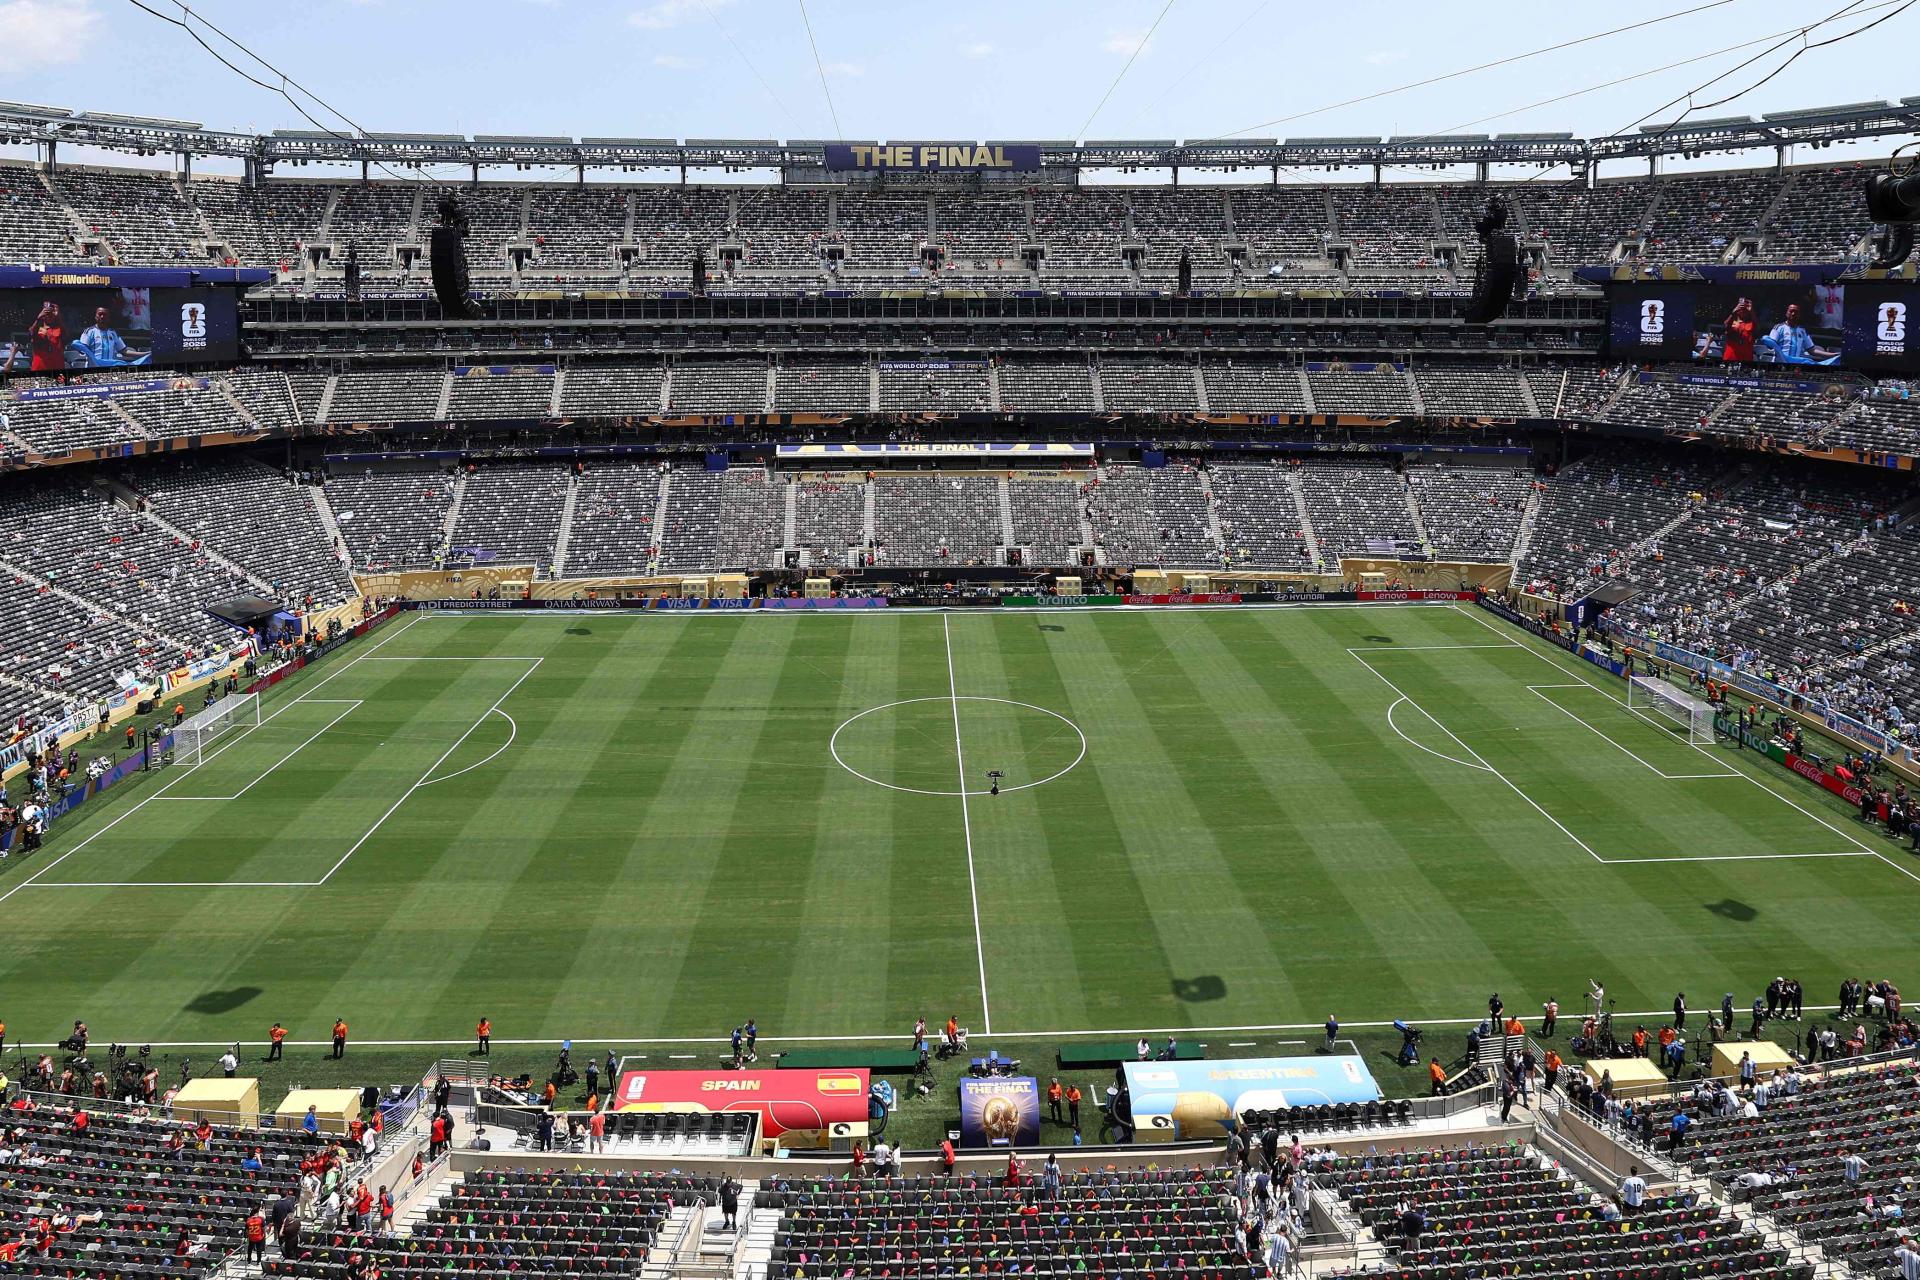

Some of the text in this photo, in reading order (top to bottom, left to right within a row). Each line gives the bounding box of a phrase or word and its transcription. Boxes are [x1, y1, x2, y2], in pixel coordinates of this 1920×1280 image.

[850, 146, 1012, 166] THE FINAL
[1736, 270, 1800, 280] #FIFAWorldCup
[41, 274, 111, 286] #FIFAWorldCup
[704, 416, 734, 425] THE
[1248, 415, 1278, 424] THE
[93, 442, 134, 458] THE
[932, 444, 977, 452] FINAL
[1856, 451, 1898, 468] THE
[1128, 595, 1154, 604] Coca-Cola
[1168, 595, 1193, 603] Coca-Cola
[1208, 594, 1233, 603] Coca-Cola
[1374, 592, 1407, 600] Lenovo
[1424, 591, 1458, 600] Lenovo
[417, 601, 441, 610] ADI
[544, 600, 621, 609] QATAR AIRWAYS
[667, 599, 692, 608] VISA
[718, 599, 743, 608] VISA
[1037, 596, 1088, 606] aramco
[1480, 598, 1489, 607] ADI
[367, 614, 388, 629] Lenovo
[1522, 619, 1572, 649] QATAR AIRWAYS
[324, 637, 347, 652] HYUNDAI
[1594, 654, 1612, 670] VISA
[1793, 759, 1824, 784] Coca-Cola
[48, 798, 70, 822] ISA
[1208, 1067, 1318, 1080] ARGENTINA
[700, 1080, 761, 1091] SPAIN
[967, 1086, 991, 1094] THE
[1633, 1184, 1641, 1193] 10
[249, 1225, 260, 1234] 22
